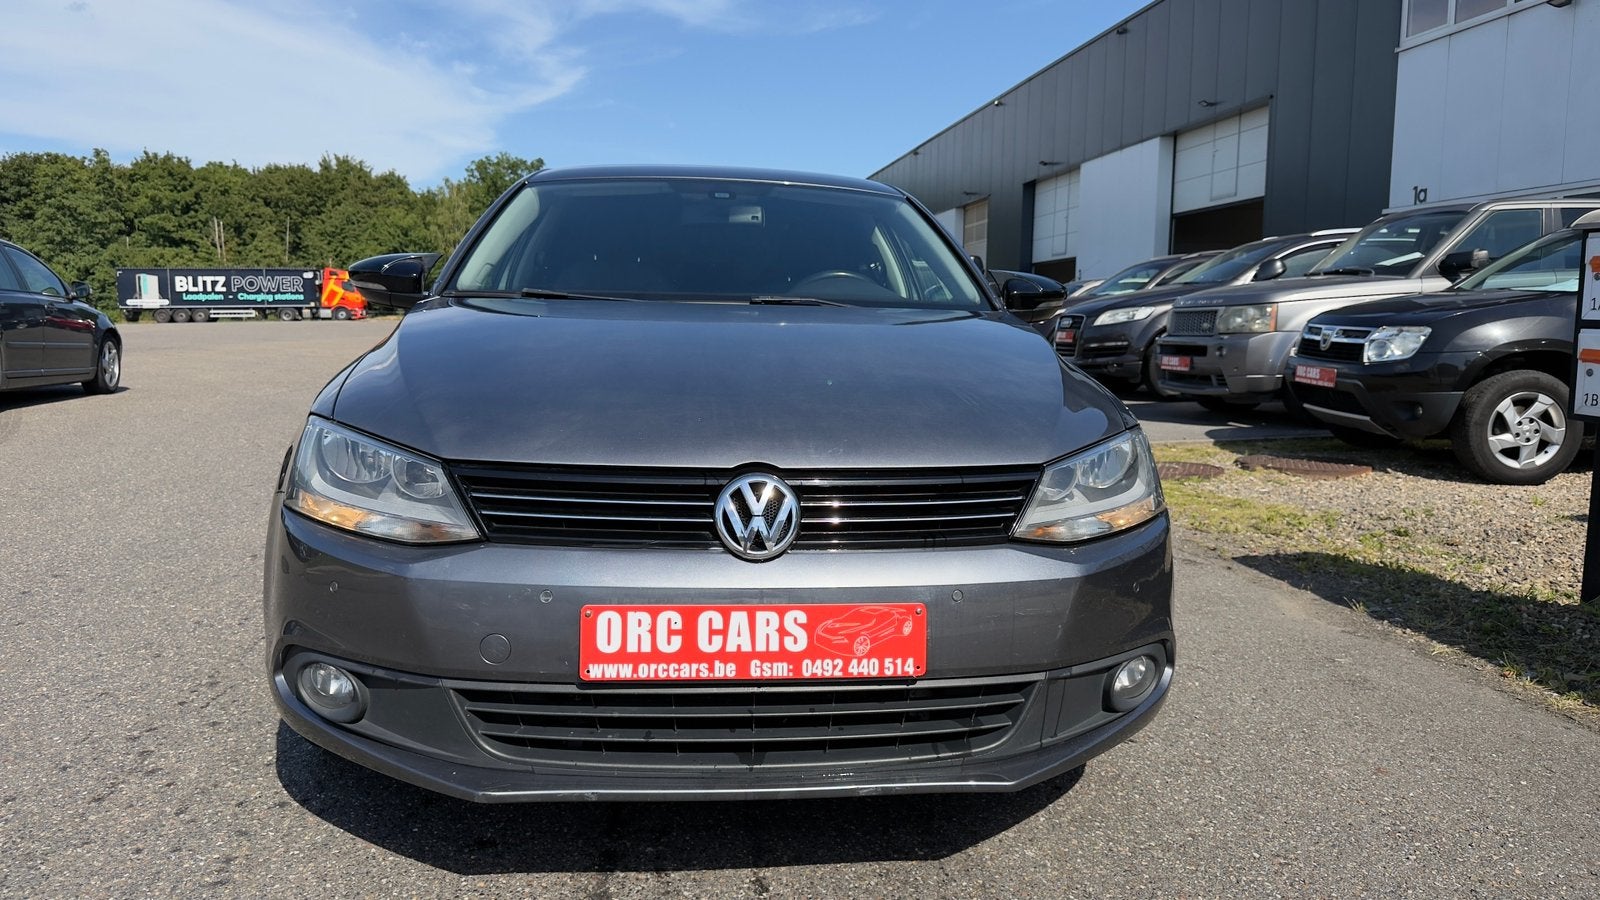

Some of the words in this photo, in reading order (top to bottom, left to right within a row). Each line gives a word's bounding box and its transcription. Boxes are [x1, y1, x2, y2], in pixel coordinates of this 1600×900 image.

[1412, 185, 1428, 206] 1a
[174, 275, 227, 292] BLITZ
[230, 275, 304, 293] POWER
[237, 292, 274, 302] Charging
[274, 292, 305, 301] stations
[1583, 392, 1599, 407] 1B
[714, 472, 800, 560] VW
[596, 610, 683, 654] ORC
[697, 609, 808, 653] CARS
[588, 660, 737, 679] www.orccars.be
[750, 659, 793, 677] Gsm:
[801, 658, 843, 676] 0492
[847, 658, 879, 676] 440
[883, 657, 915, 676] 514
